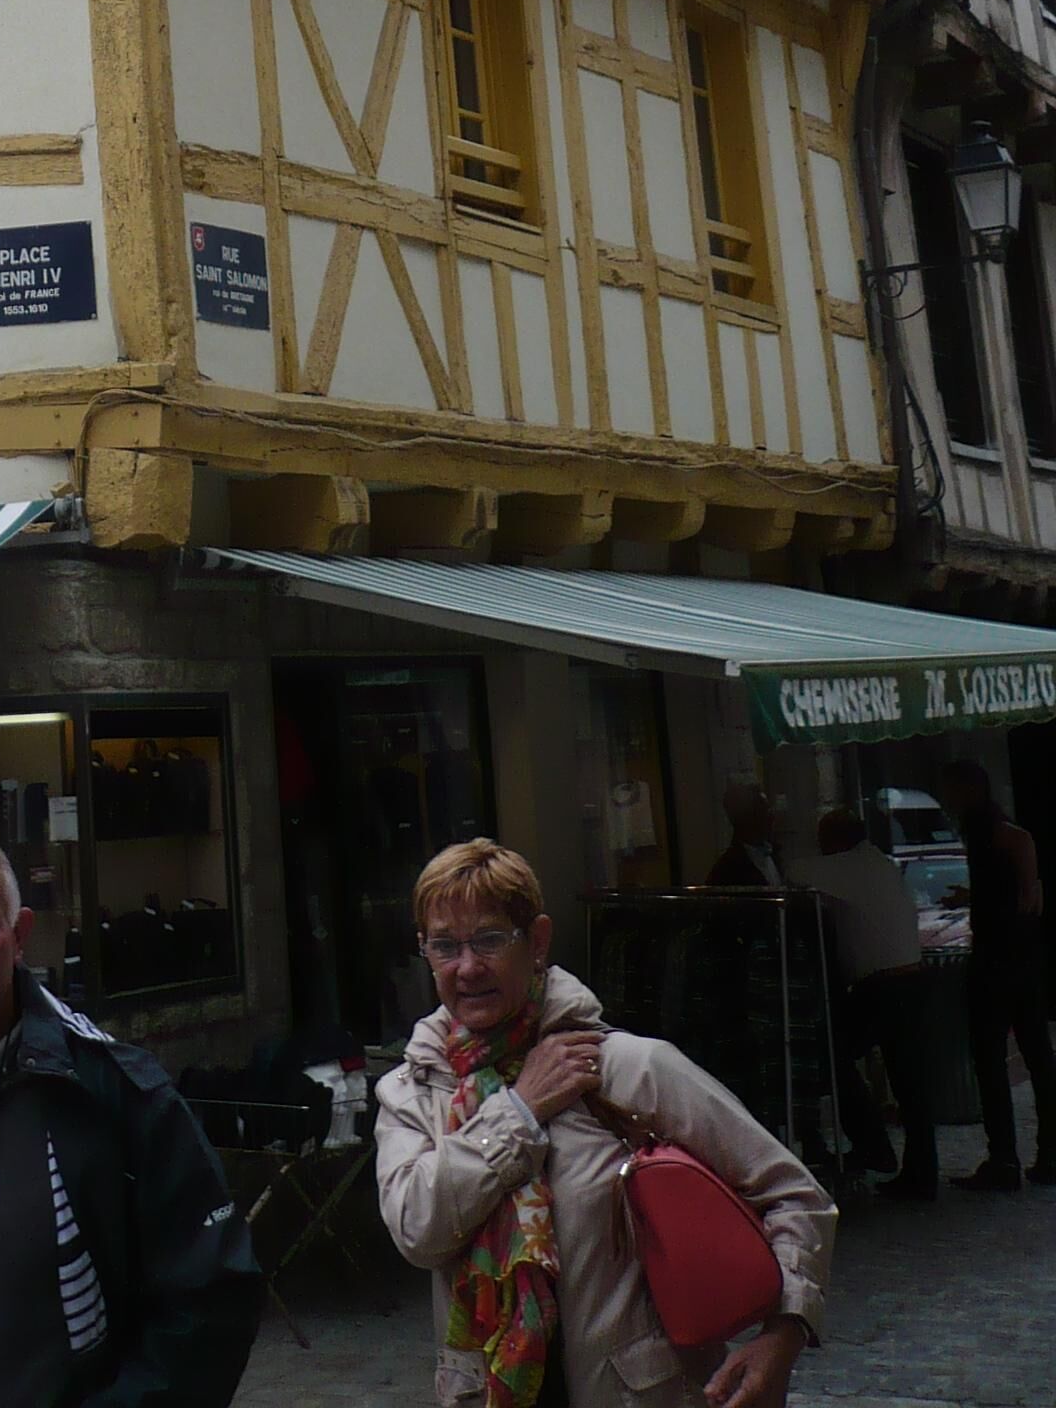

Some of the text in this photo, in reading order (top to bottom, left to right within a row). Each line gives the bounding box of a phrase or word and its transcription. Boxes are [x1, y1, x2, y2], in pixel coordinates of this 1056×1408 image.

[0, 246, 51, 265] PLACE
[221, 245, 240, 264] RUE
[43, 267, 62, 285] IV
[195, 263, 268, 292] SAINT SALOMON
[9, 292, 21, 301] de
[24, 287, 61, 299] FRANCE
[780, 663, 1055, 728] CHEMISERIE M. LOISEAU
